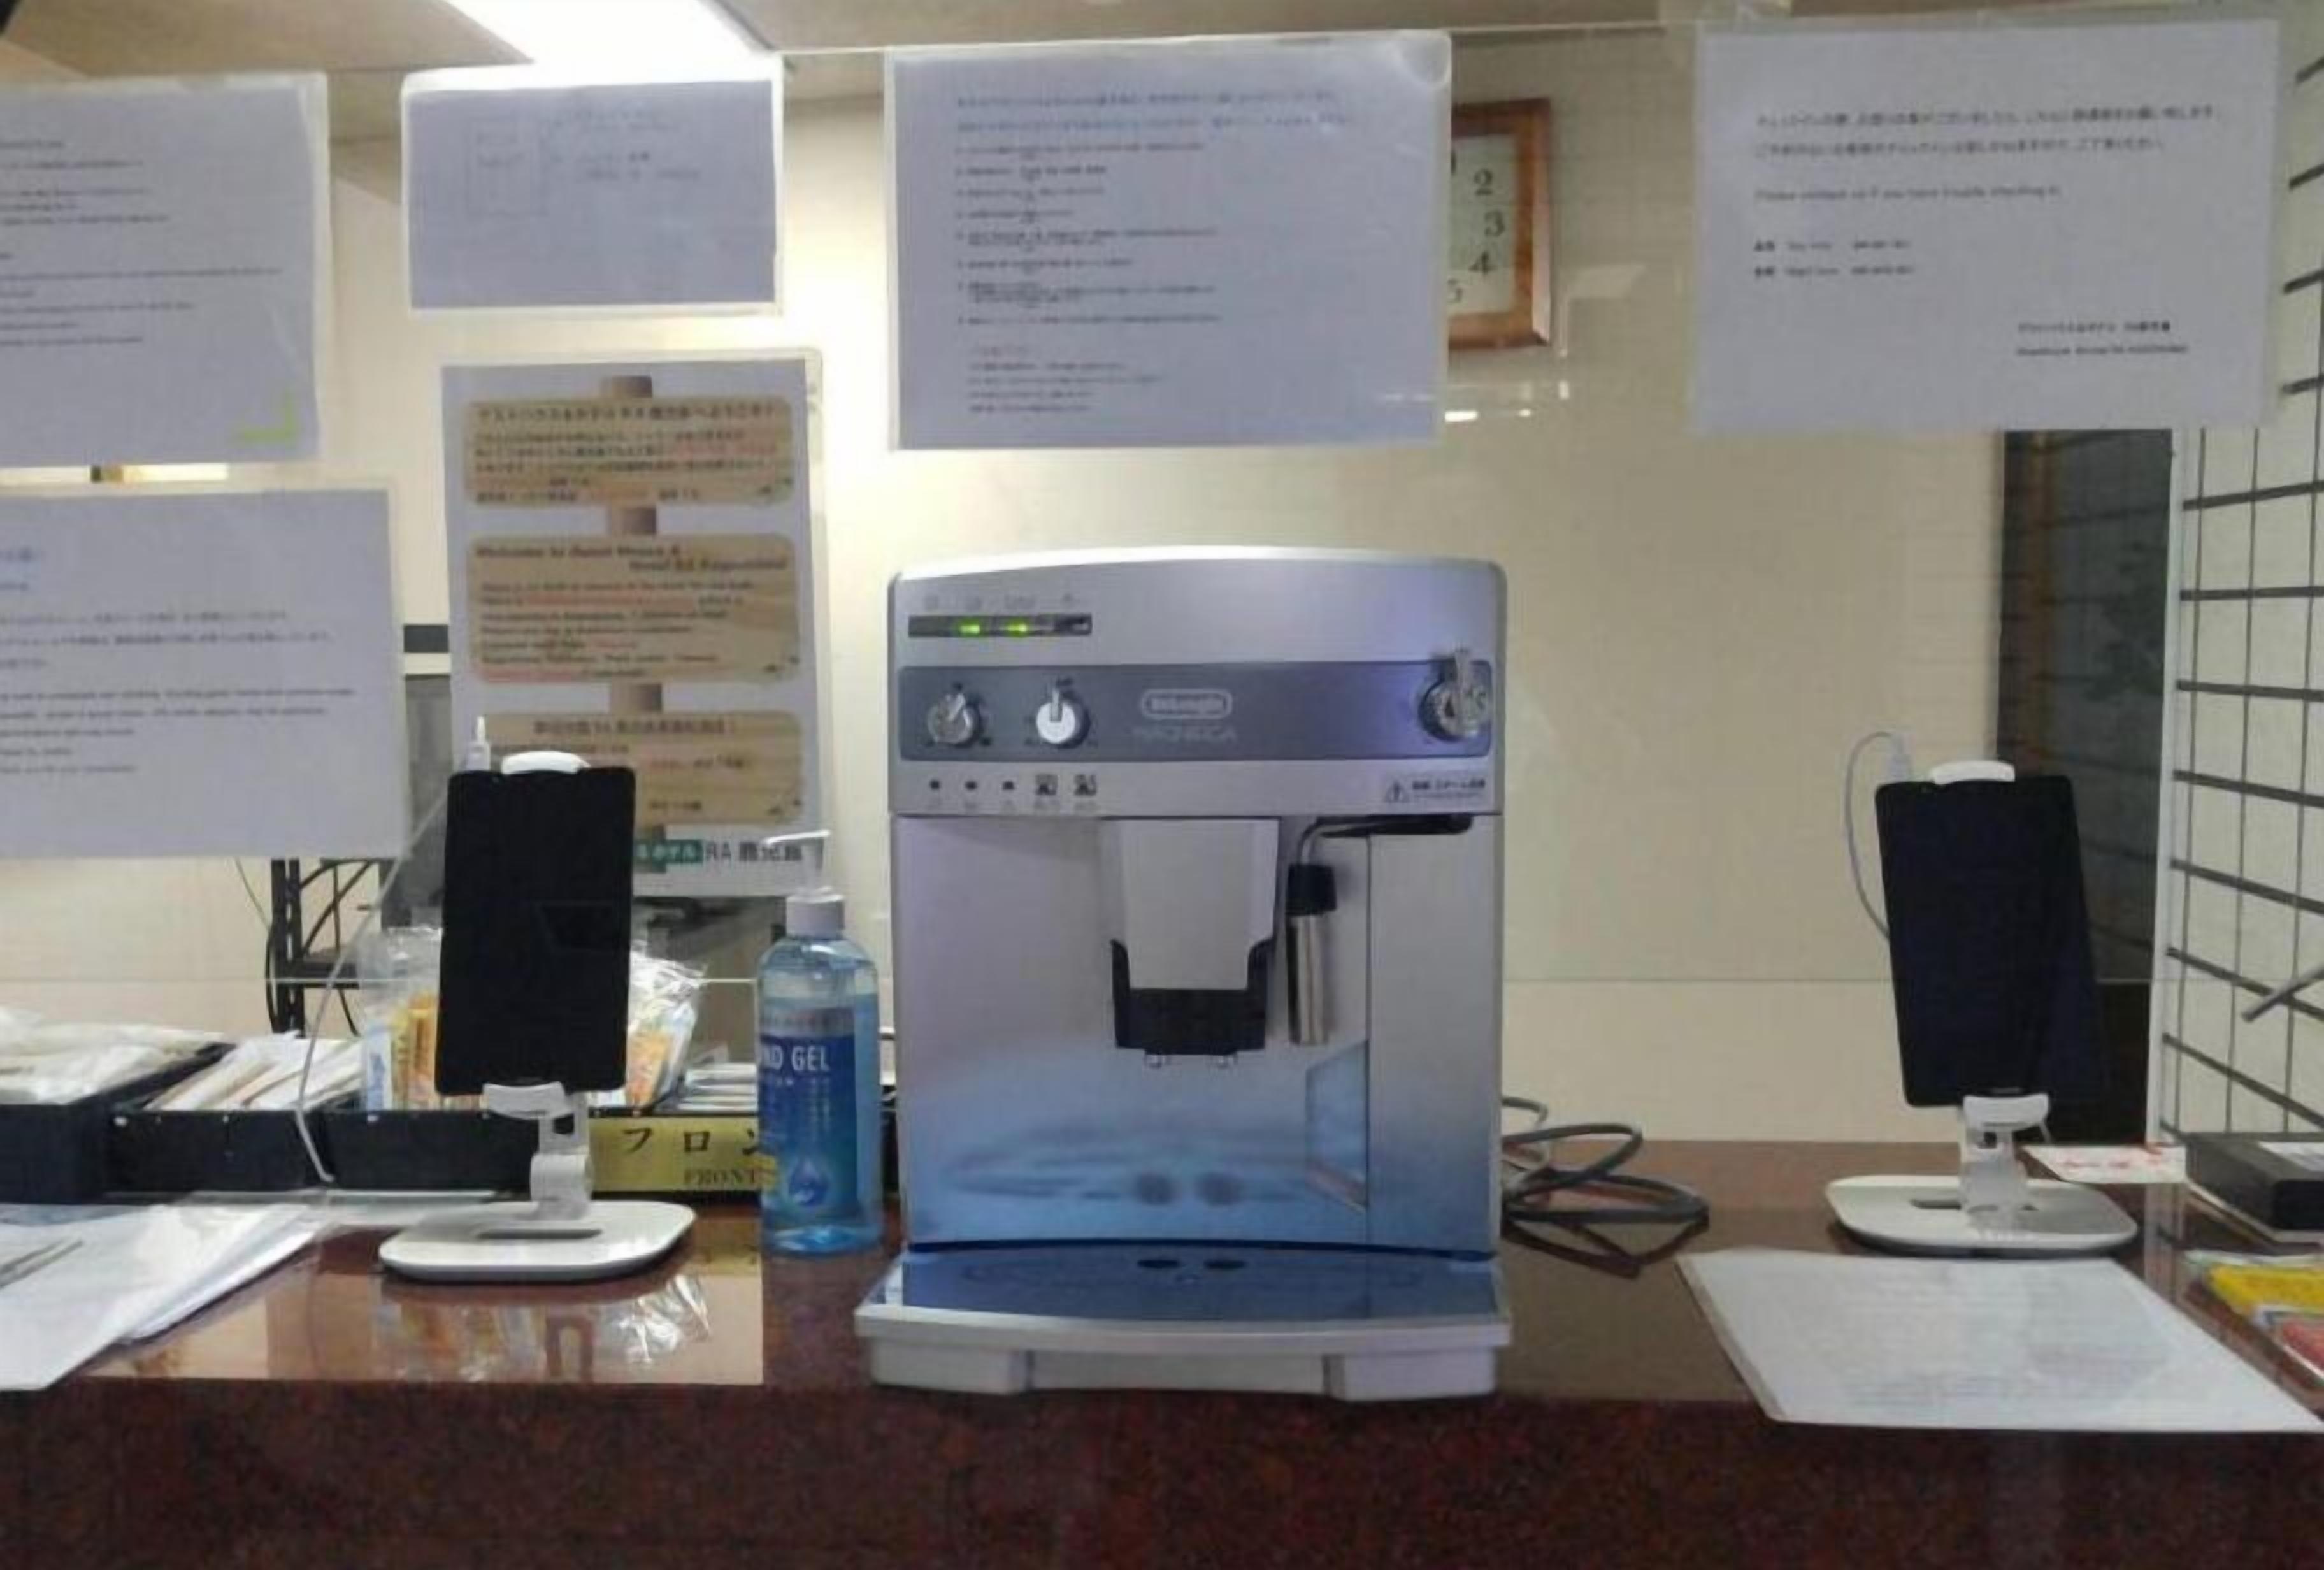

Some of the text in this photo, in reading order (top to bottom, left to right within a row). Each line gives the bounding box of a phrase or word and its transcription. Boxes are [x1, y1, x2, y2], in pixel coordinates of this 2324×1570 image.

[1474, 168, 1493, 196] 2
[1484, 209, 1505, 238] 3
[1467, 250, 1495, 275] 4
[791, 1045, 829, 1072] GEL
